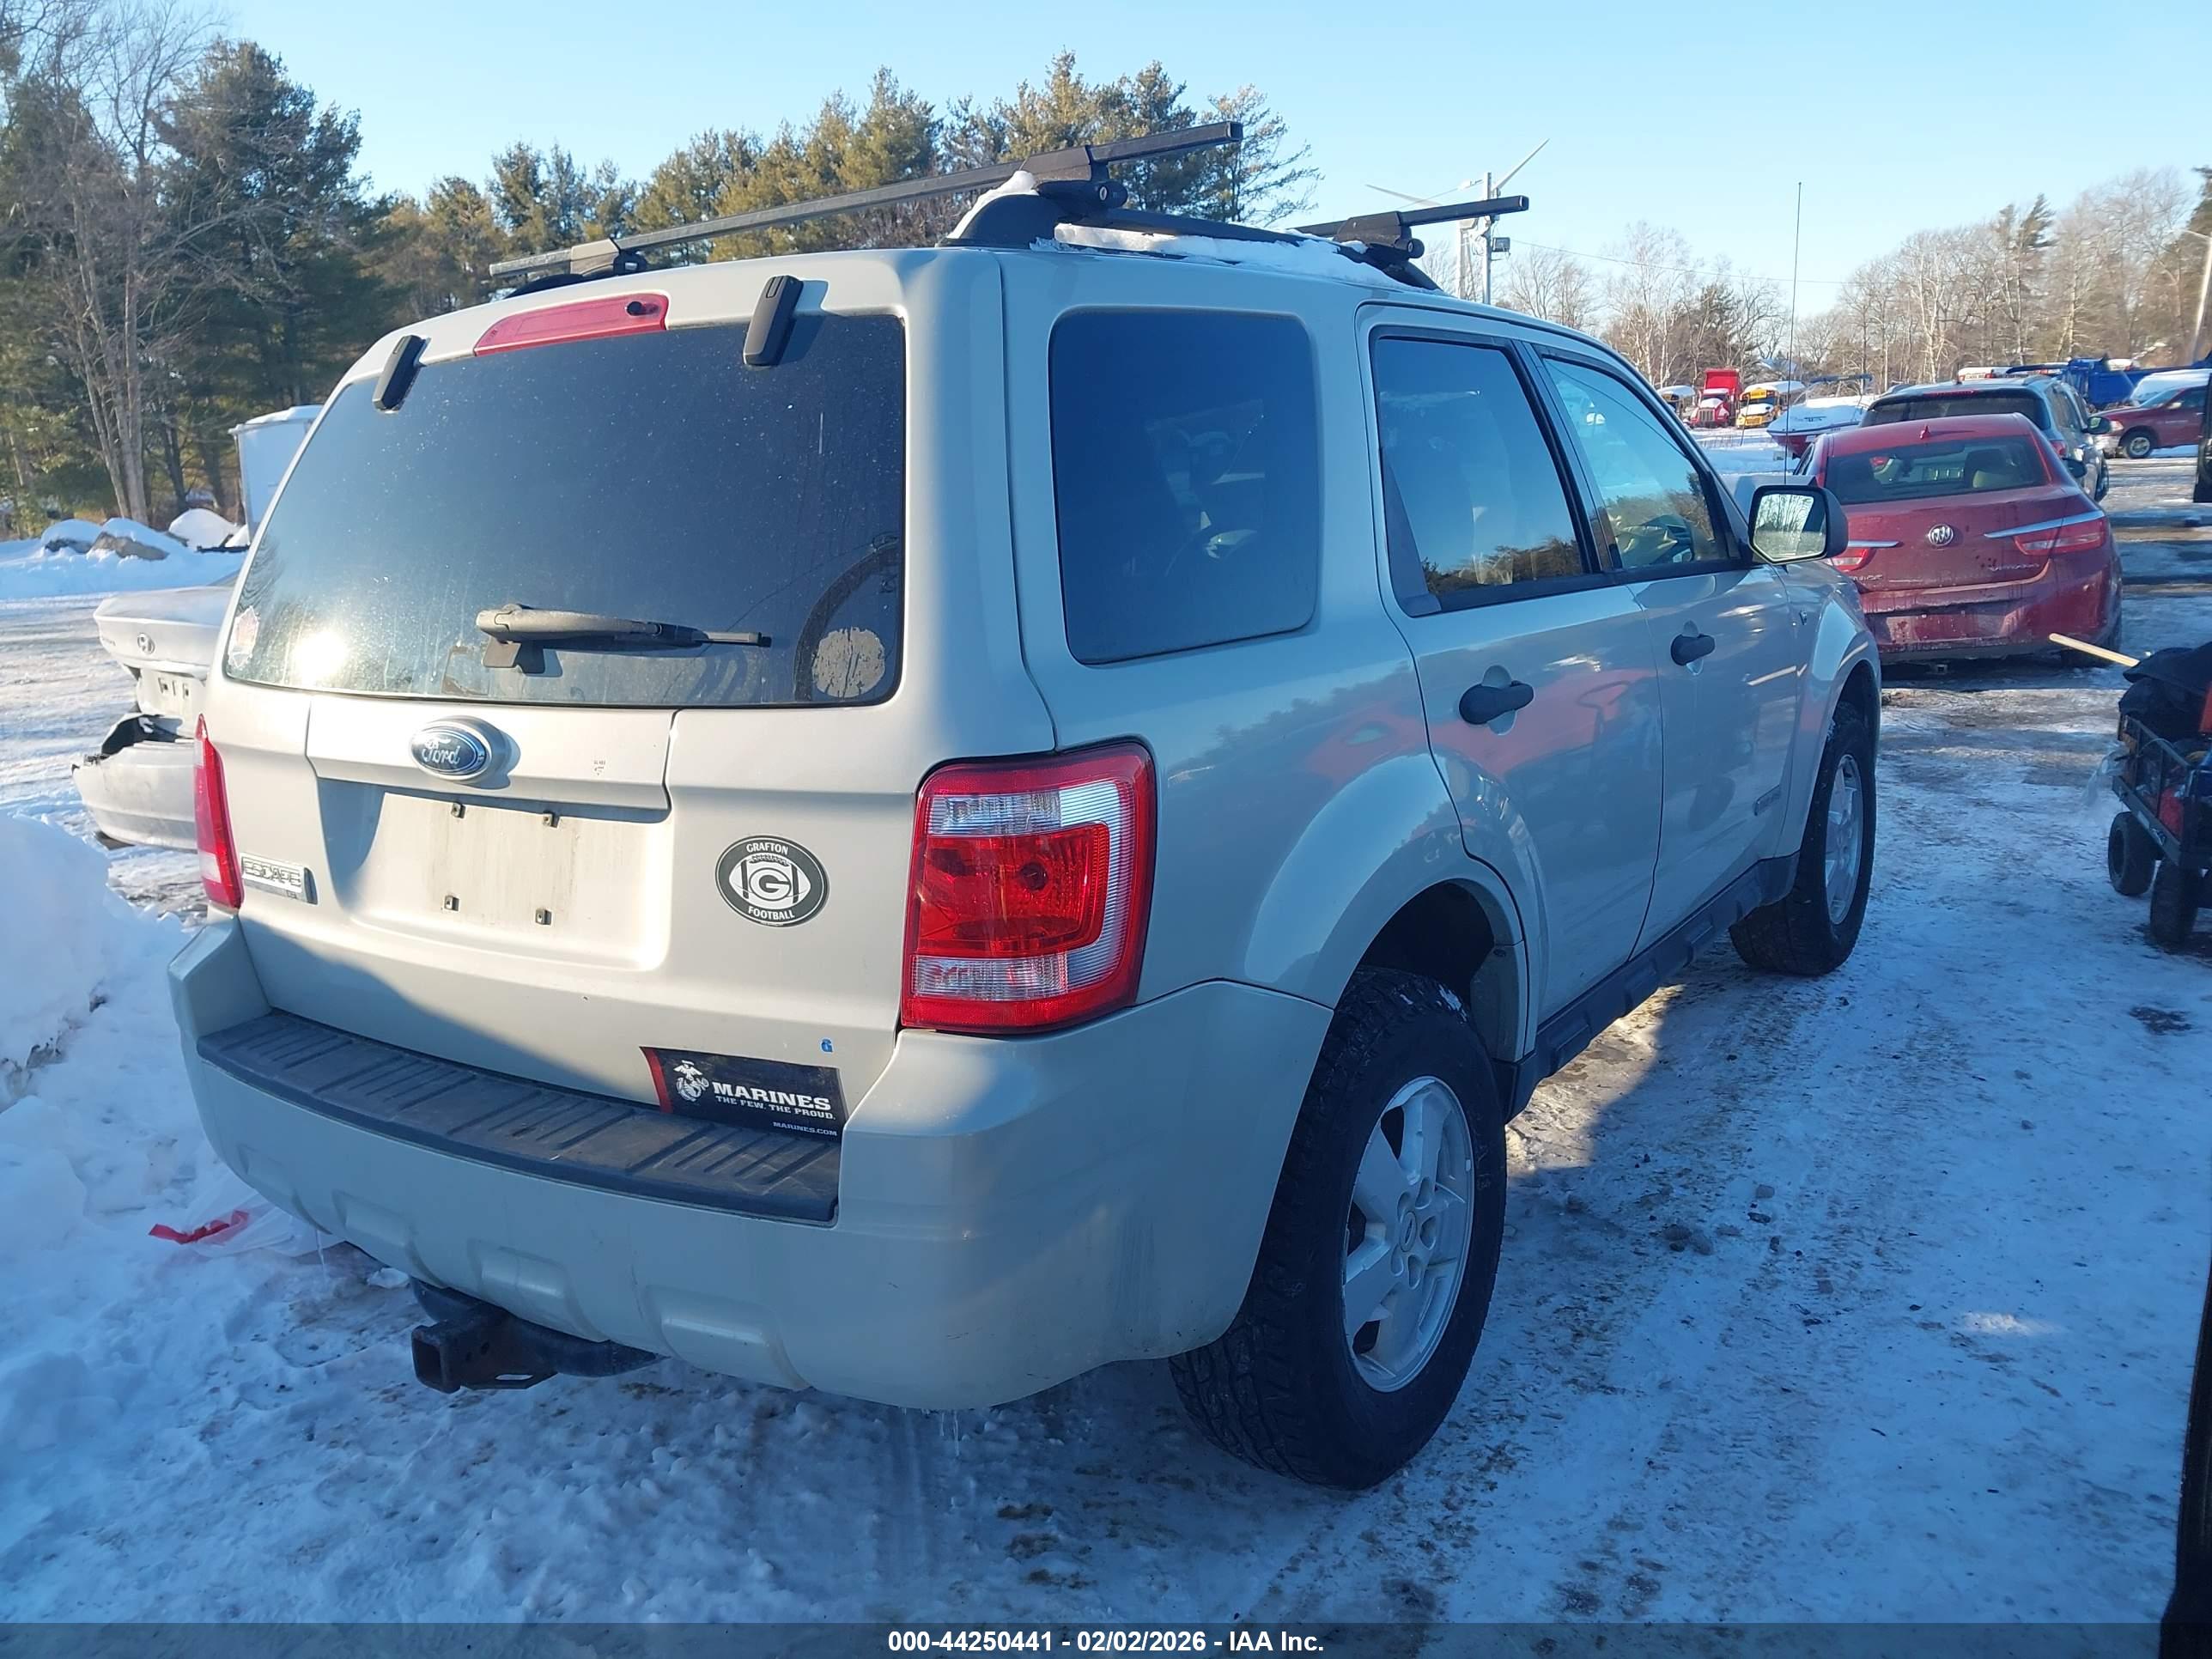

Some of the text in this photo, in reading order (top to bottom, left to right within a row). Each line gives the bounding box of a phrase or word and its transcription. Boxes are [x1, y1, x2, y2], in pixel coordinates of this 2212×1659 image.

[421, 740, 461, 765] Ford
[745, 842, 789, 855] GRAFTON
[243, 860, 302, 888] ESCAPE
[748, 905, 796, 921] FOOTBALL
[711, 1081, 832, 1111] MARINES
[715, 1095, 836, 1121] THE FEW. THE PROUD.
[773, 1121, 838, 1137] MARINES.COM
